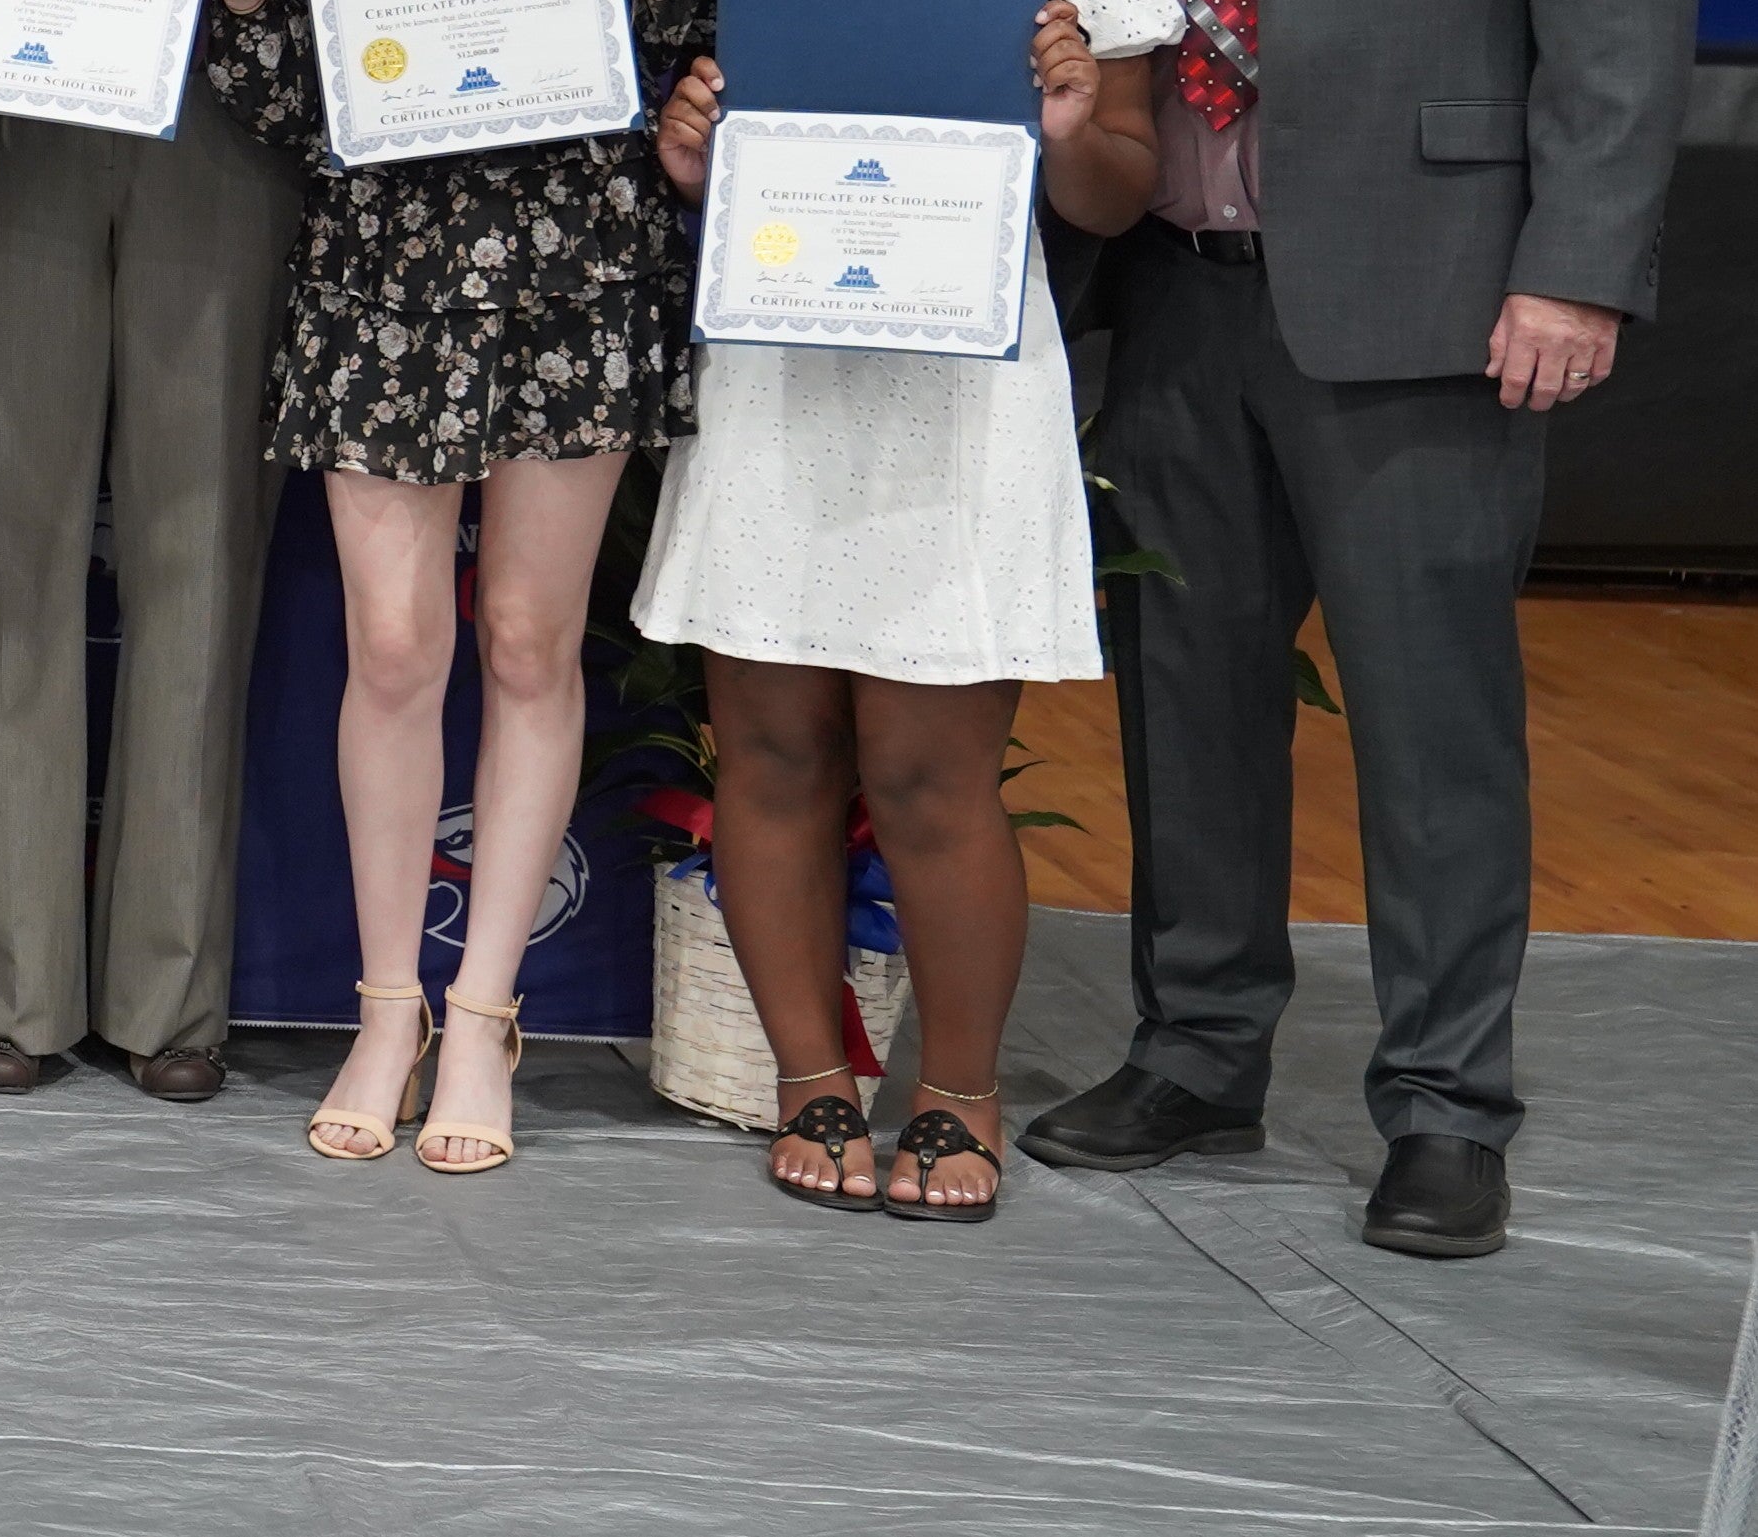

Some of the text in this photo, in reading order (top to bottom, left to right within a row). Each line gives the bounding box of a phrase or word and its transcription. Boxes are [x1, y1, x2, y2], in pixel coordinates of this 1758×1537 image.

[374, 23, 393, 32] May
[412, 17, 440, 27] known
[440, 14, 456, 23] that
[456, 11, 473, 21] this
[472, 6, 514, 18] Certificate
[22, 73, 40, 83] OF
[42, 75, 137, 98] SCHOLARSHIP
[379, 86, 594, 126] CERTIFICATE OF SCHOLARSHIP
[760, 188, 983, 210] CERTIFICATE OF SCHOLARSHIP
[749, 293, 973, 318] CERTIFICATE OF SCHOLARSHIP
